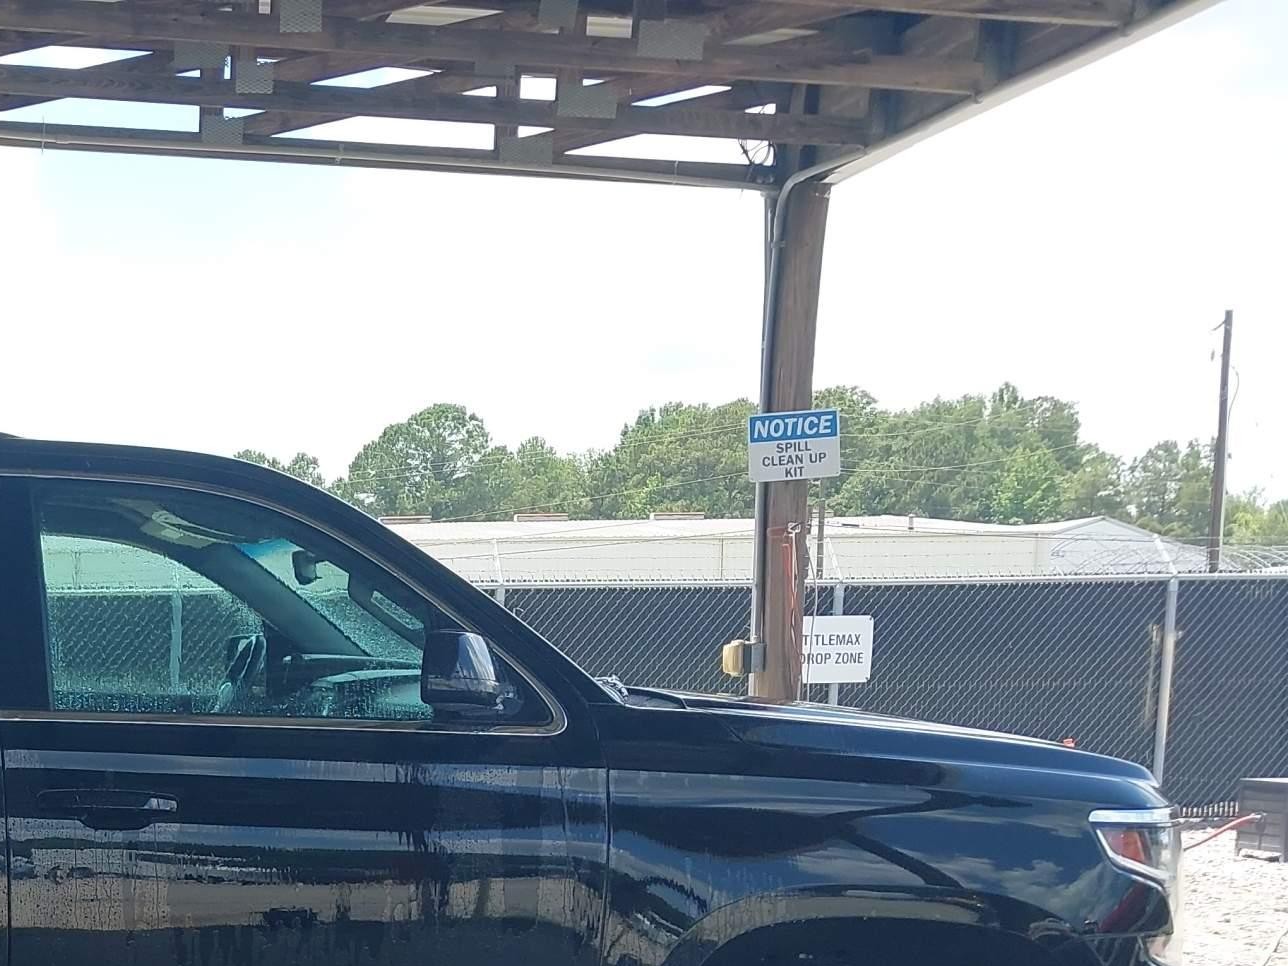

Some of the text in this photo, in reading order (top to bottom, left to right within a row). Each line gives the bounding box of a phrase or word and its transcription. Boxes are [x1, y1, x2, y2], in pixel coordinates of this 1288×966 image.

[754, 415, 833, 438] NOTICE
[776, 441, 811, 453] SPILL
[762, 452, 827, 467] CLEAN UP
[785, 466, 805, 478] KIT
[802, 633, 861, 646] TTLEMAX
[835, 652, 864, 664] ZONE
